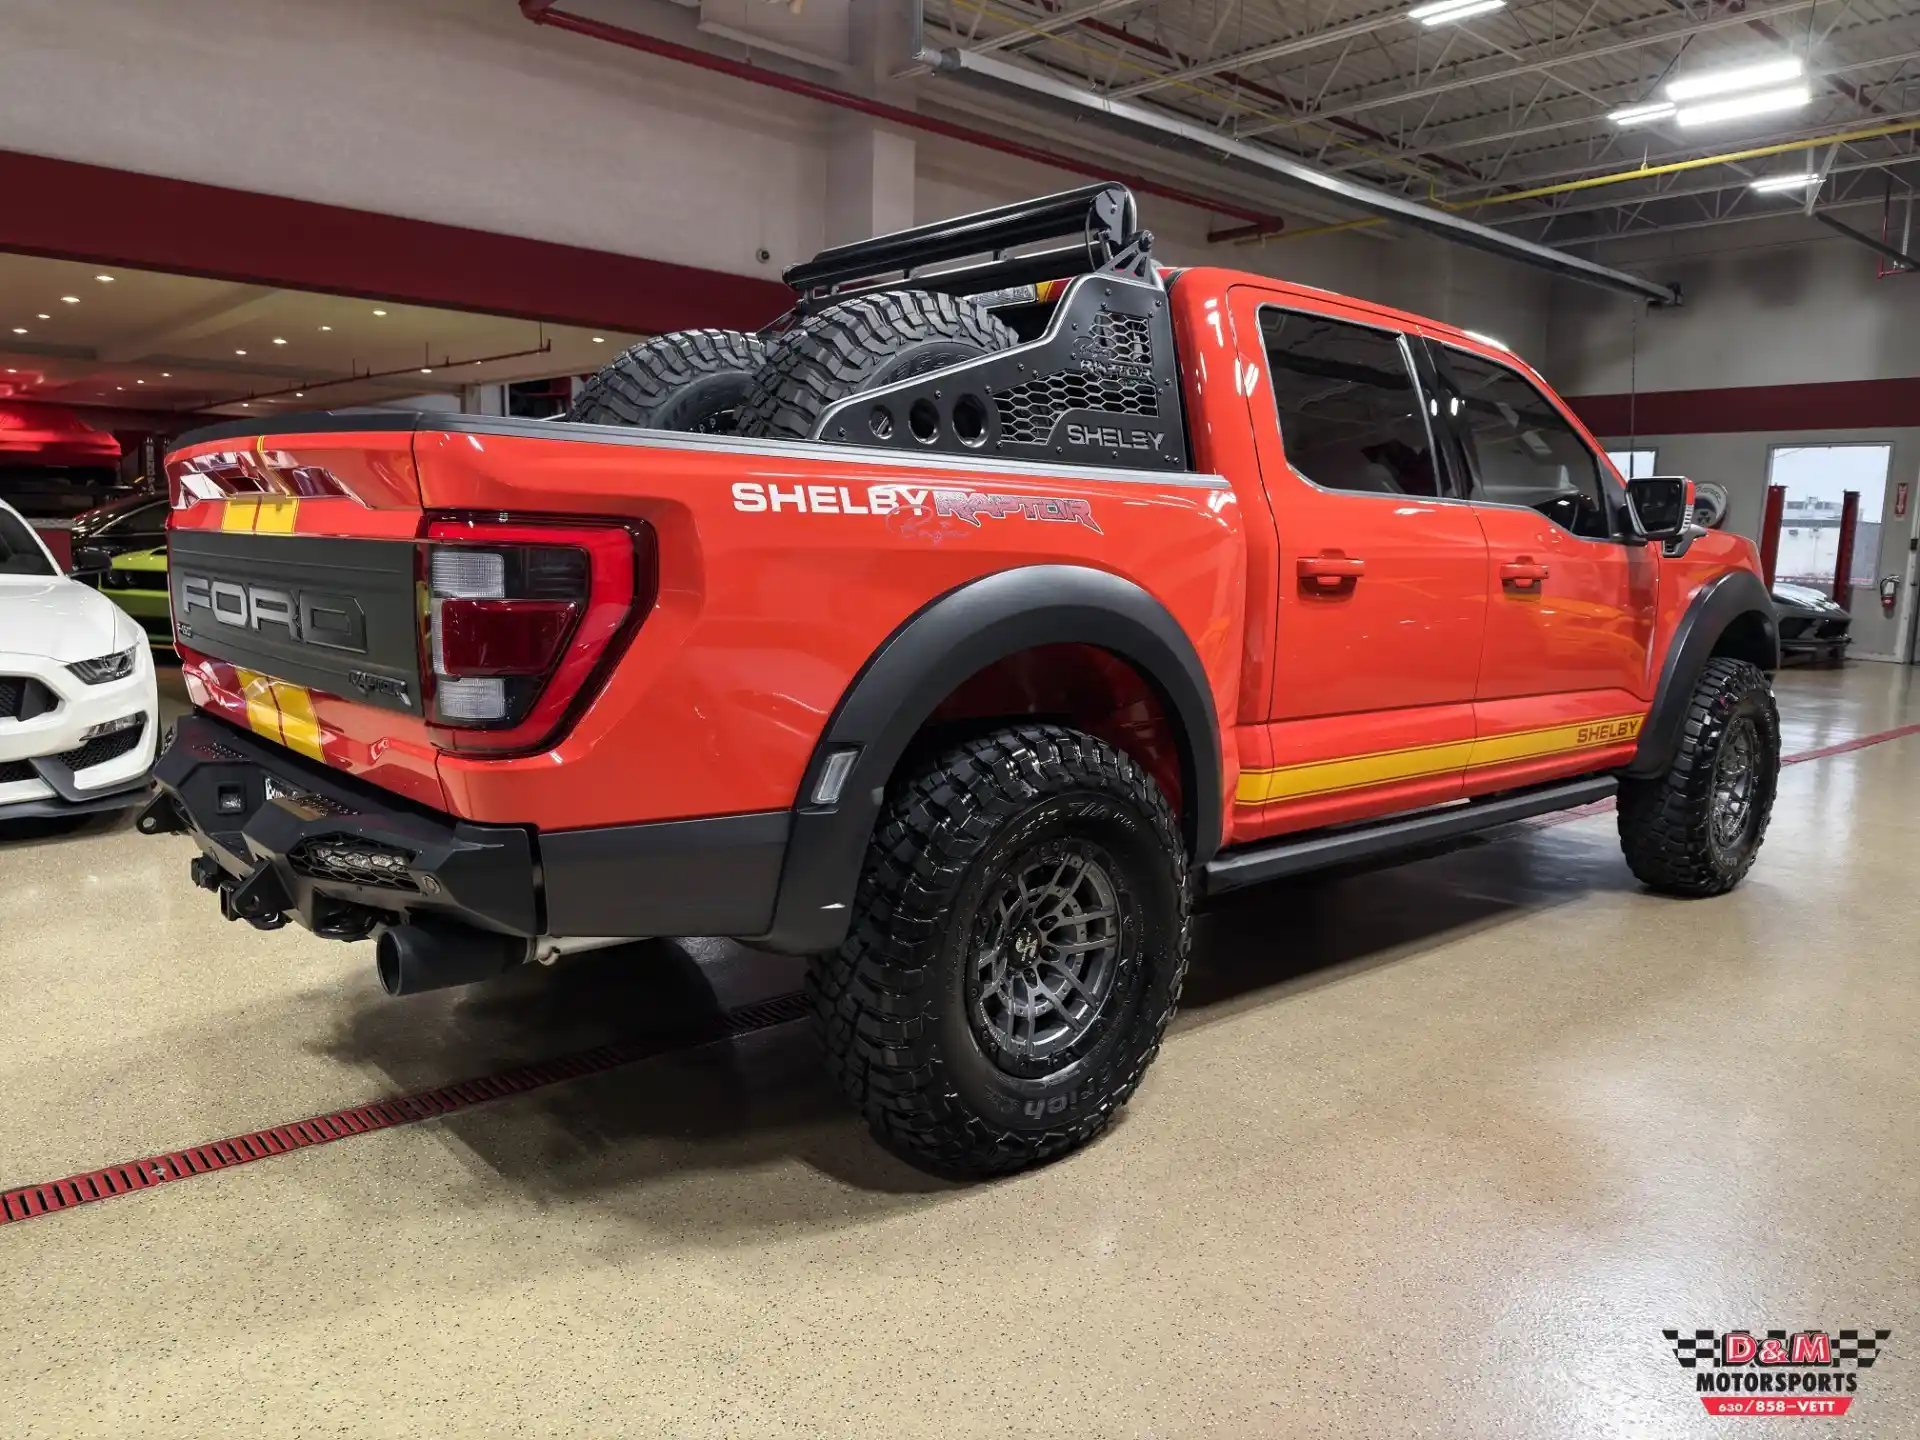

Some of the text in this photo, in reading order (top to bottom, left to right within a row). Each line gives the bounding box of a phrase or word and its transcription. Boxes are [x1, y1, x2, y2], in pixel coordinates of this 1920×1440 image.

[1067, 424, 1165, 450] SHELBY
[731, 482, 927, 516] SHELBY
[932, 489, 1104, 536] RAPTOR
[182, 573, 368, 654] FORD
[1577, 720, 1638, 743] SHELBY
